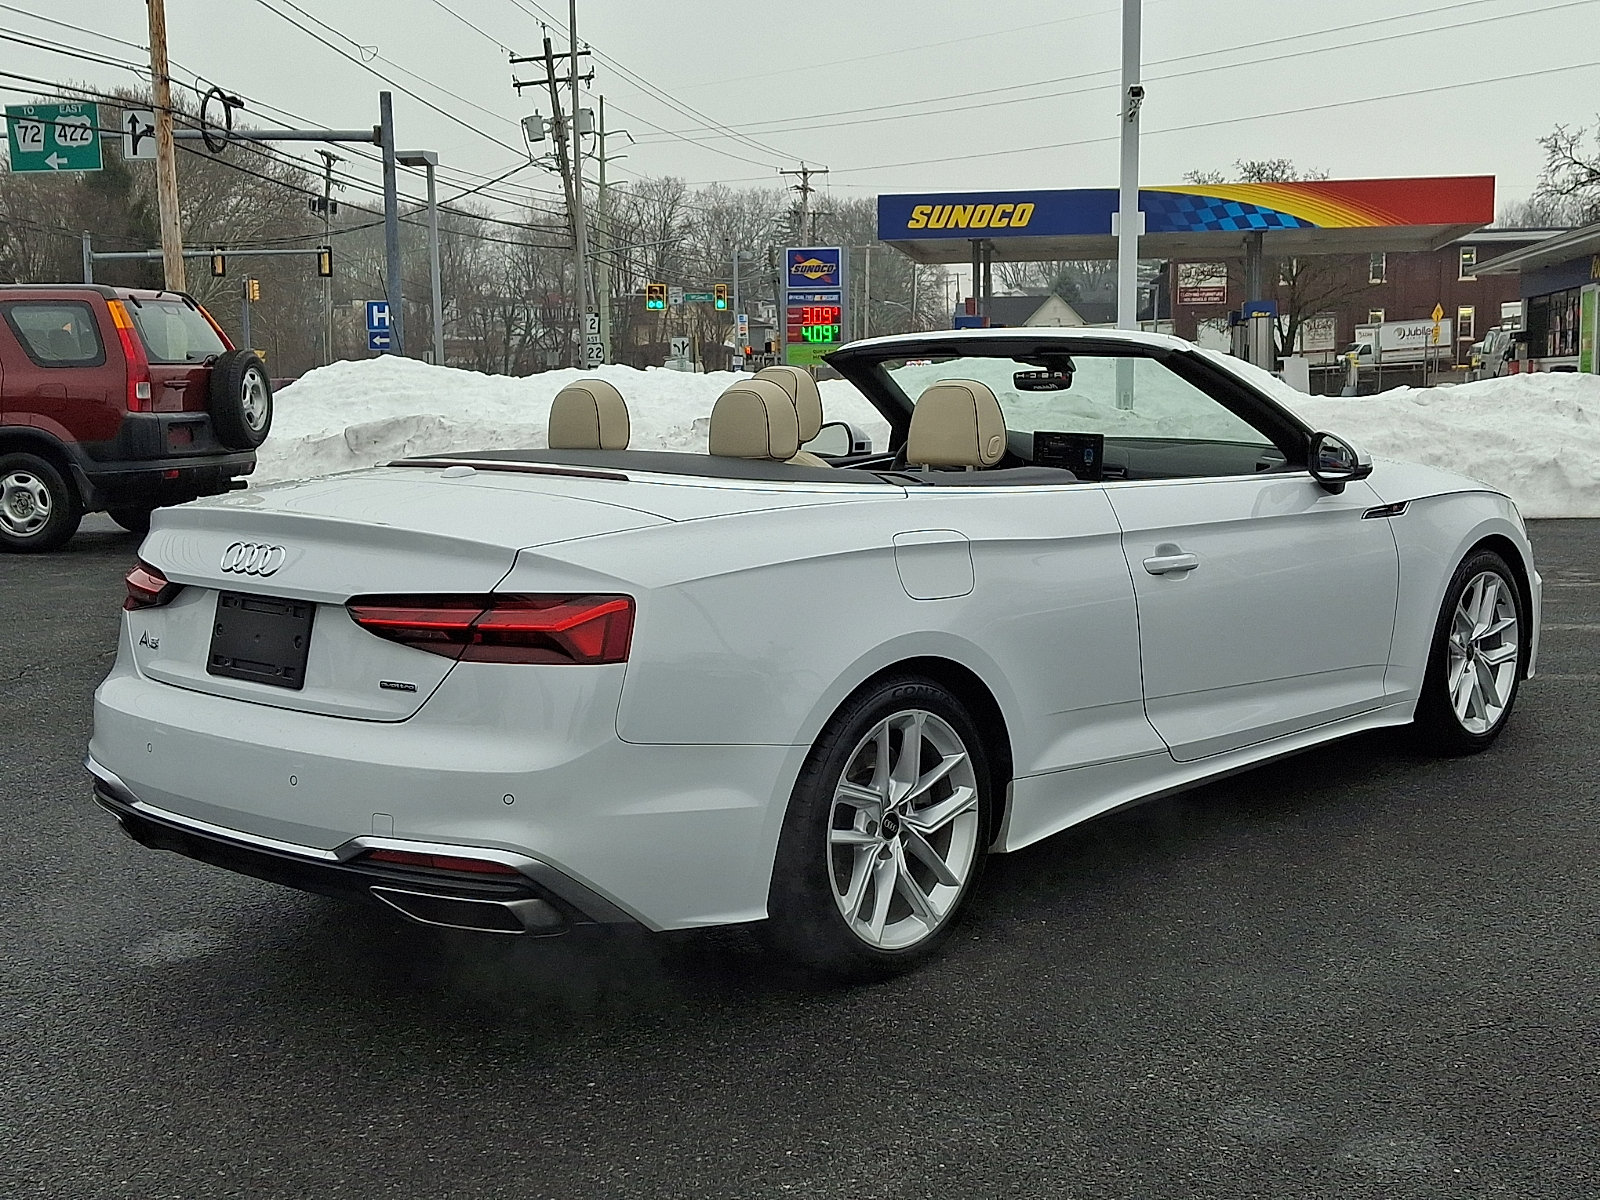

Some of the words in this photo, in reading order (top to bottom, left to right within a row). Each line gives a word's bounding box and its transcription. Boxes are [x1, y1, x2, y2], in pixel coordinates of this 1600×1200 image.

[23, 106, 34, 115] TO
[60, 104, 82, 113] EAST
[18, 125, 41, 143] 72
[58, 123, 90, 141] 422
[907, 203, 1035, 228] SUNOCO
[794, 264, 834, 273] SUNOCO
[373, 305, 389, 326] H
[1406, 326, 1434, 337] Jubile
[587, 347, 602, 358] 22
[138, 629, 160, 650] A5
